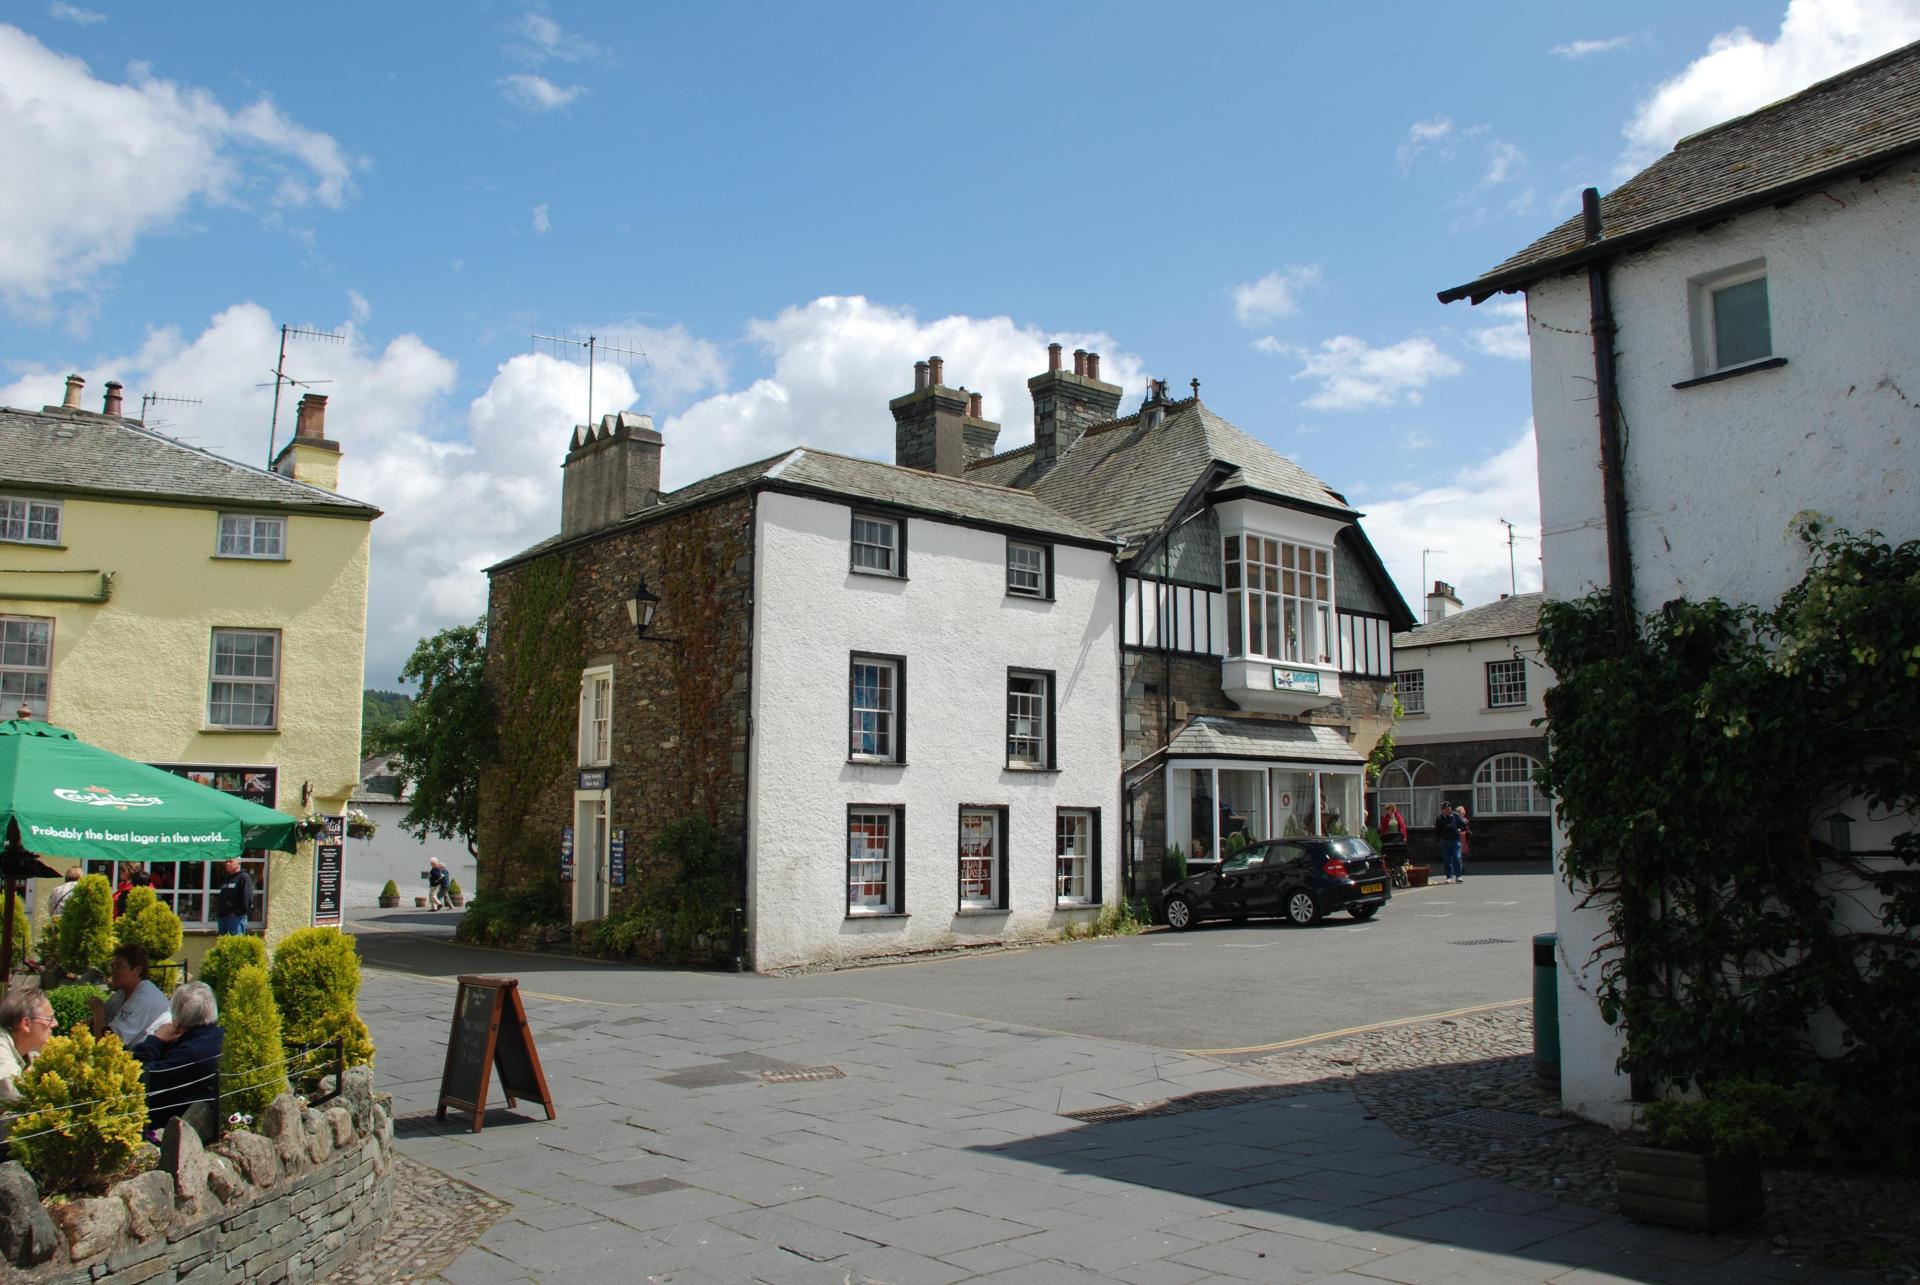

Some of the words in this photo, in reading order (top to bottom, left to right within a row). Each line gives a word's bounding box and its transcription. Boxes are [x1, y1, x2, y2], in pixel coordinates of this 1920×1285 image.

[53, 788, 164, 806] Carlsberg
[31, 825, 83, 841] Probably
[84, 828, 103, 841] the
[104, 829, 129, 842] best
[130, 830, 159, 845] lager
[160, 831, 171, 843] in
[172, 831, 190, 843] the
[191, 831, 231, 843] world...
[962, 844, 983, 854] MAPS
